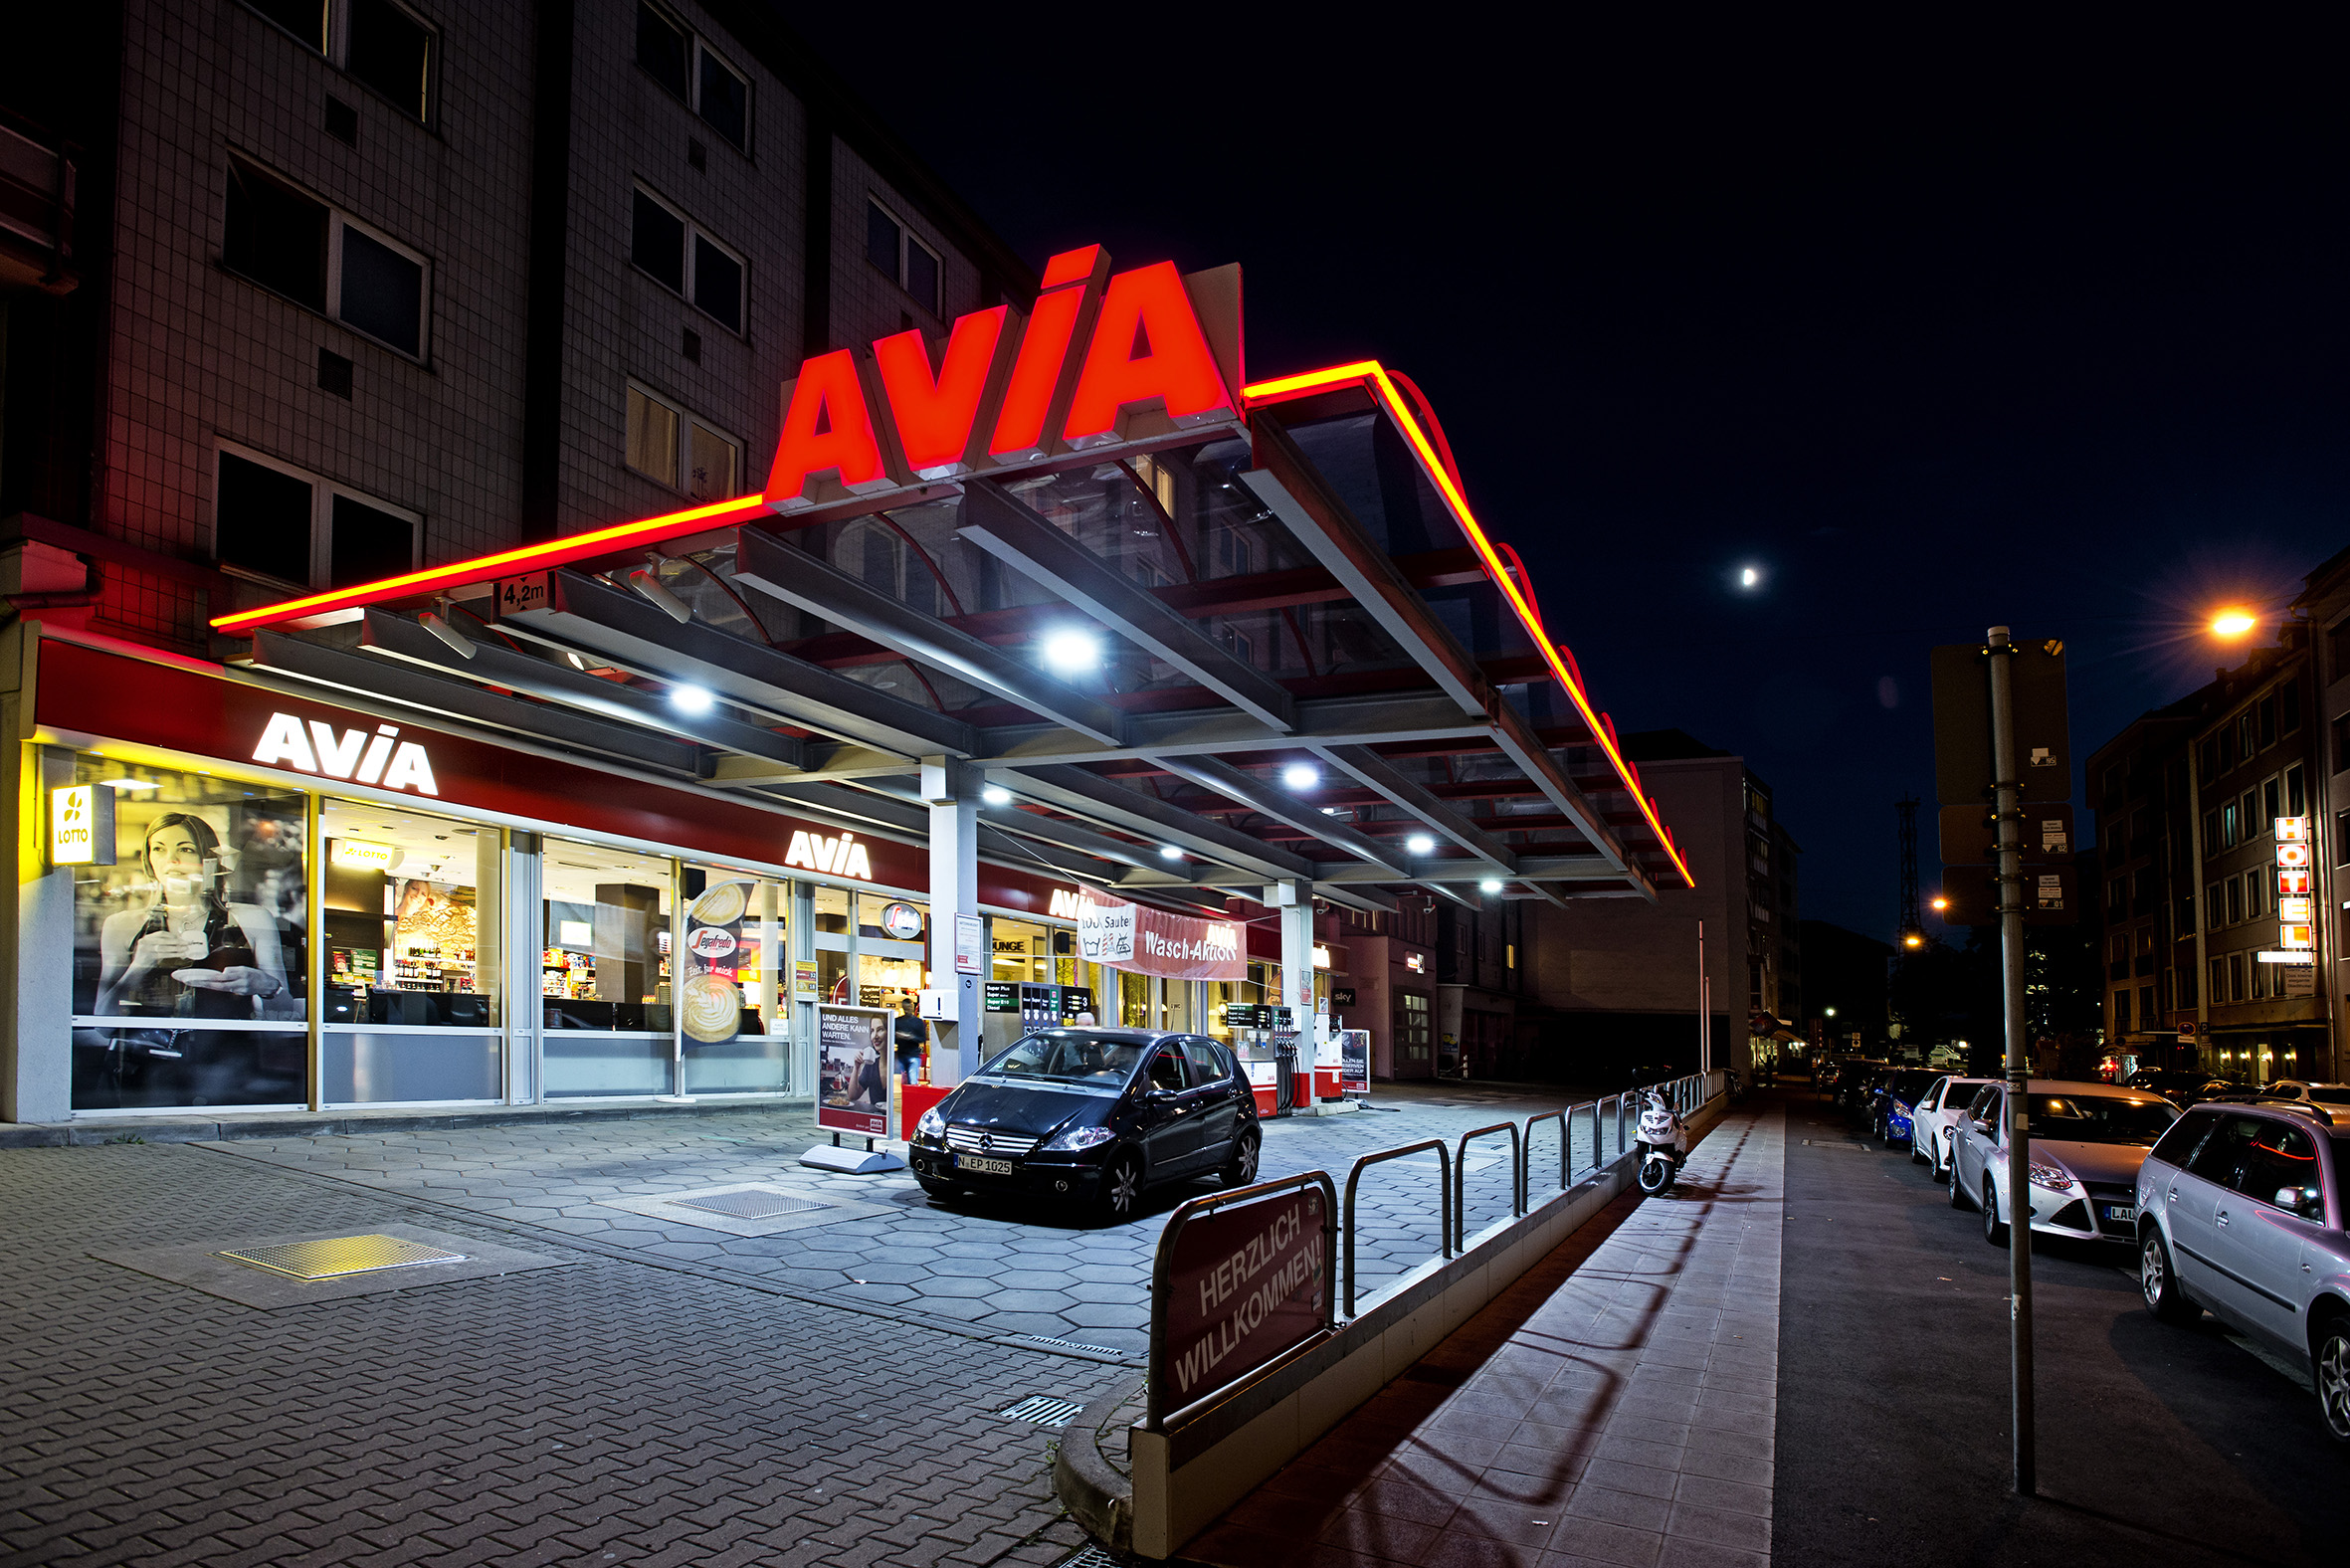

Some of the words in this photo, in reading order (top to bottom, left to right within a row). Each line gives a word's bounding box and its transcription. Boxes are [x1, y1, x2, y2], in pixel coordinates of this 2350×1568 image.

[503, 583, 543, 606] 4,2m
[58, 828, 89, 845] LOTTO
[358, 850, 388, 861] LOTTO
[2276, 818, 2311, 947] HOTEL
[691, 930, 732, 949] Segafredo
[1145, 930, 1237, 961] Wasch-Aktion
[1082, 997, 1087, 1007] 3
[1334, 992, 1352, 1002] sky
[822, 1023, 849, 1032] ANDERE
[850, 1025, 870, 1034] KANN
[822, 1031, 852, 1041] WARTEN.
[958, 1156, 965, 1167] N
[970, 1158, 983, 1169] EP
[985, 1160, 1011, 1174] 1025
[1199, 1203, 1300, 1318] HERZLICH
[1174, 1234, 1321, 1394] WILLKOMMEN!
